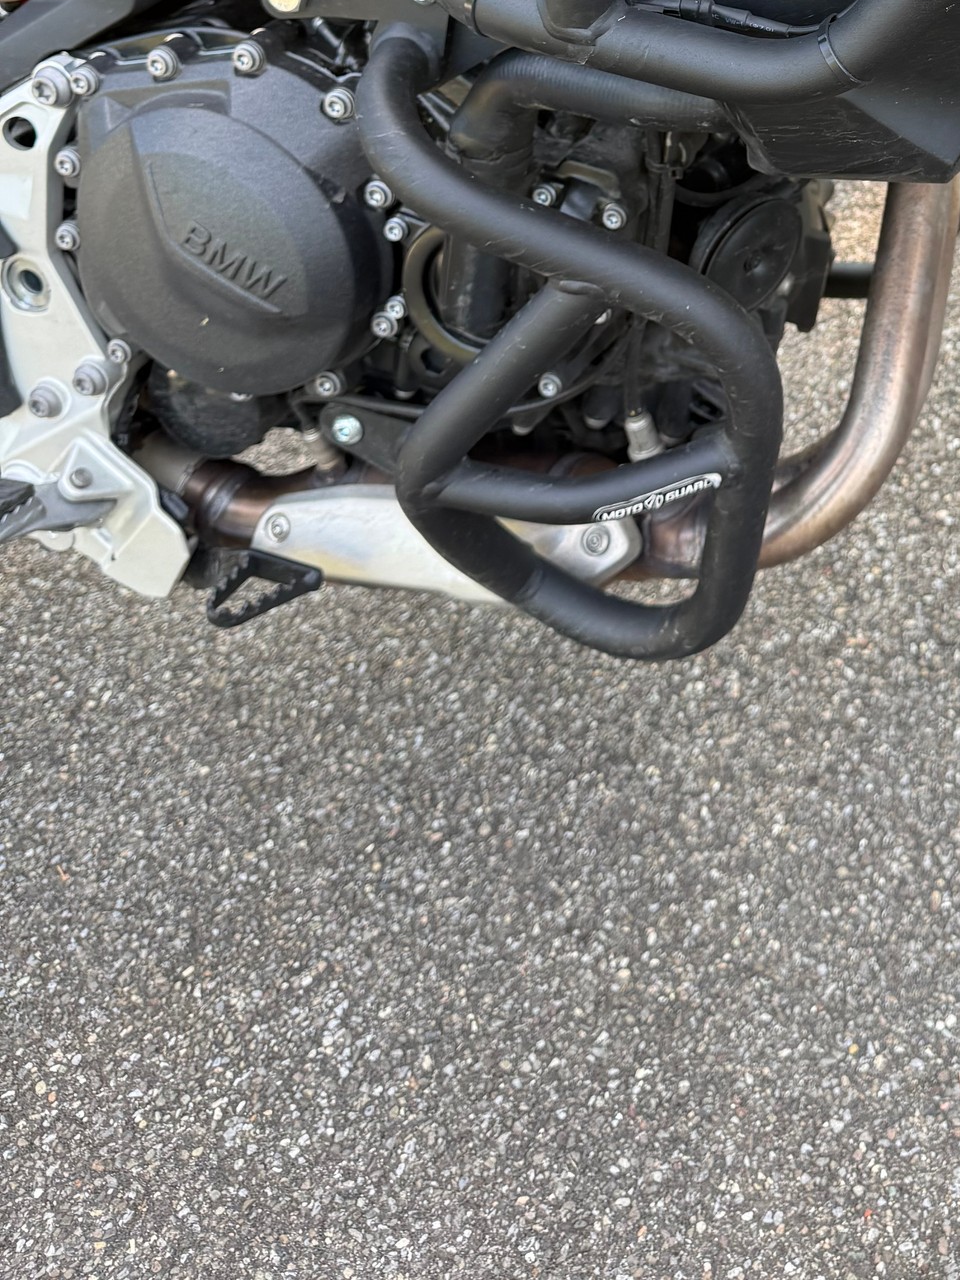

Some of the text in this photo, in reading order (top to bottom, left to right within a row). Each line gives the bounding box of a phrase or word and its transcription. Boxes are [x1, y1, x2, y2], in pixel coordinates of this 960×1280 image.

[181, 220, 288, 300] BMW
[601, 479, 713, 521] MOTO GUARD
